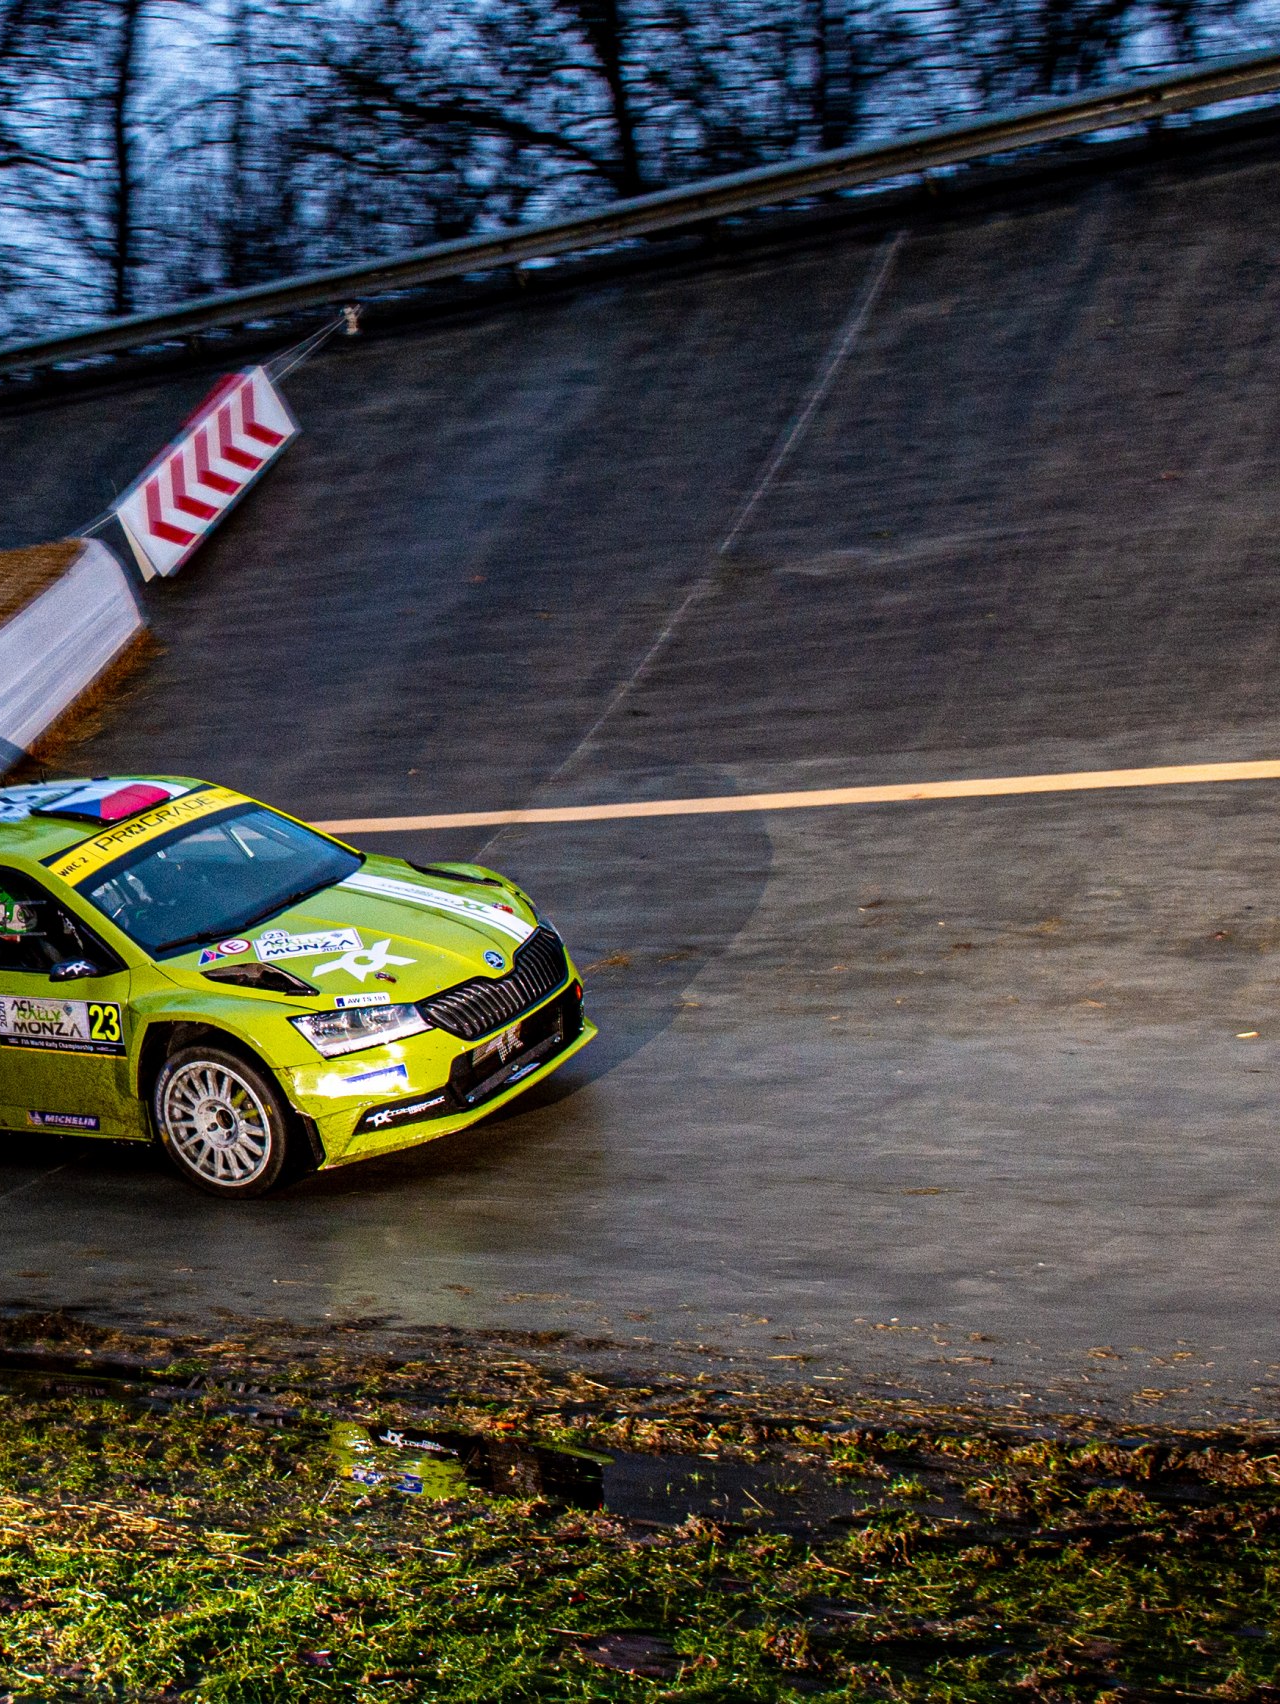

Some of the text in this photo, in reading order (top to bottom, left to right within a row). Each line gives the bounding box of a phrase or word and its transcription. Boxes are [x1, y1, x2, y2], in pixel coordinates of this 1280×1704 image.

[58, 856, 88, 877] WRC 2
[263, 938, 289, 947] ACI
[266, 939, 354, 956] MONZA
[11, 1000, 32, 1011] ACI
[17, 1009, 62, 1021] RALLY
[13, 1021, 83, 1038] MONZA
[89, 1004, 121, 1042] 23
[30, 1039, 44, 1047] World
[45, 1040, 58, 1049] Rally
[58, 1041, 94, 1052] Championship
[44, 1114, 97, 1126] MICHELIN
